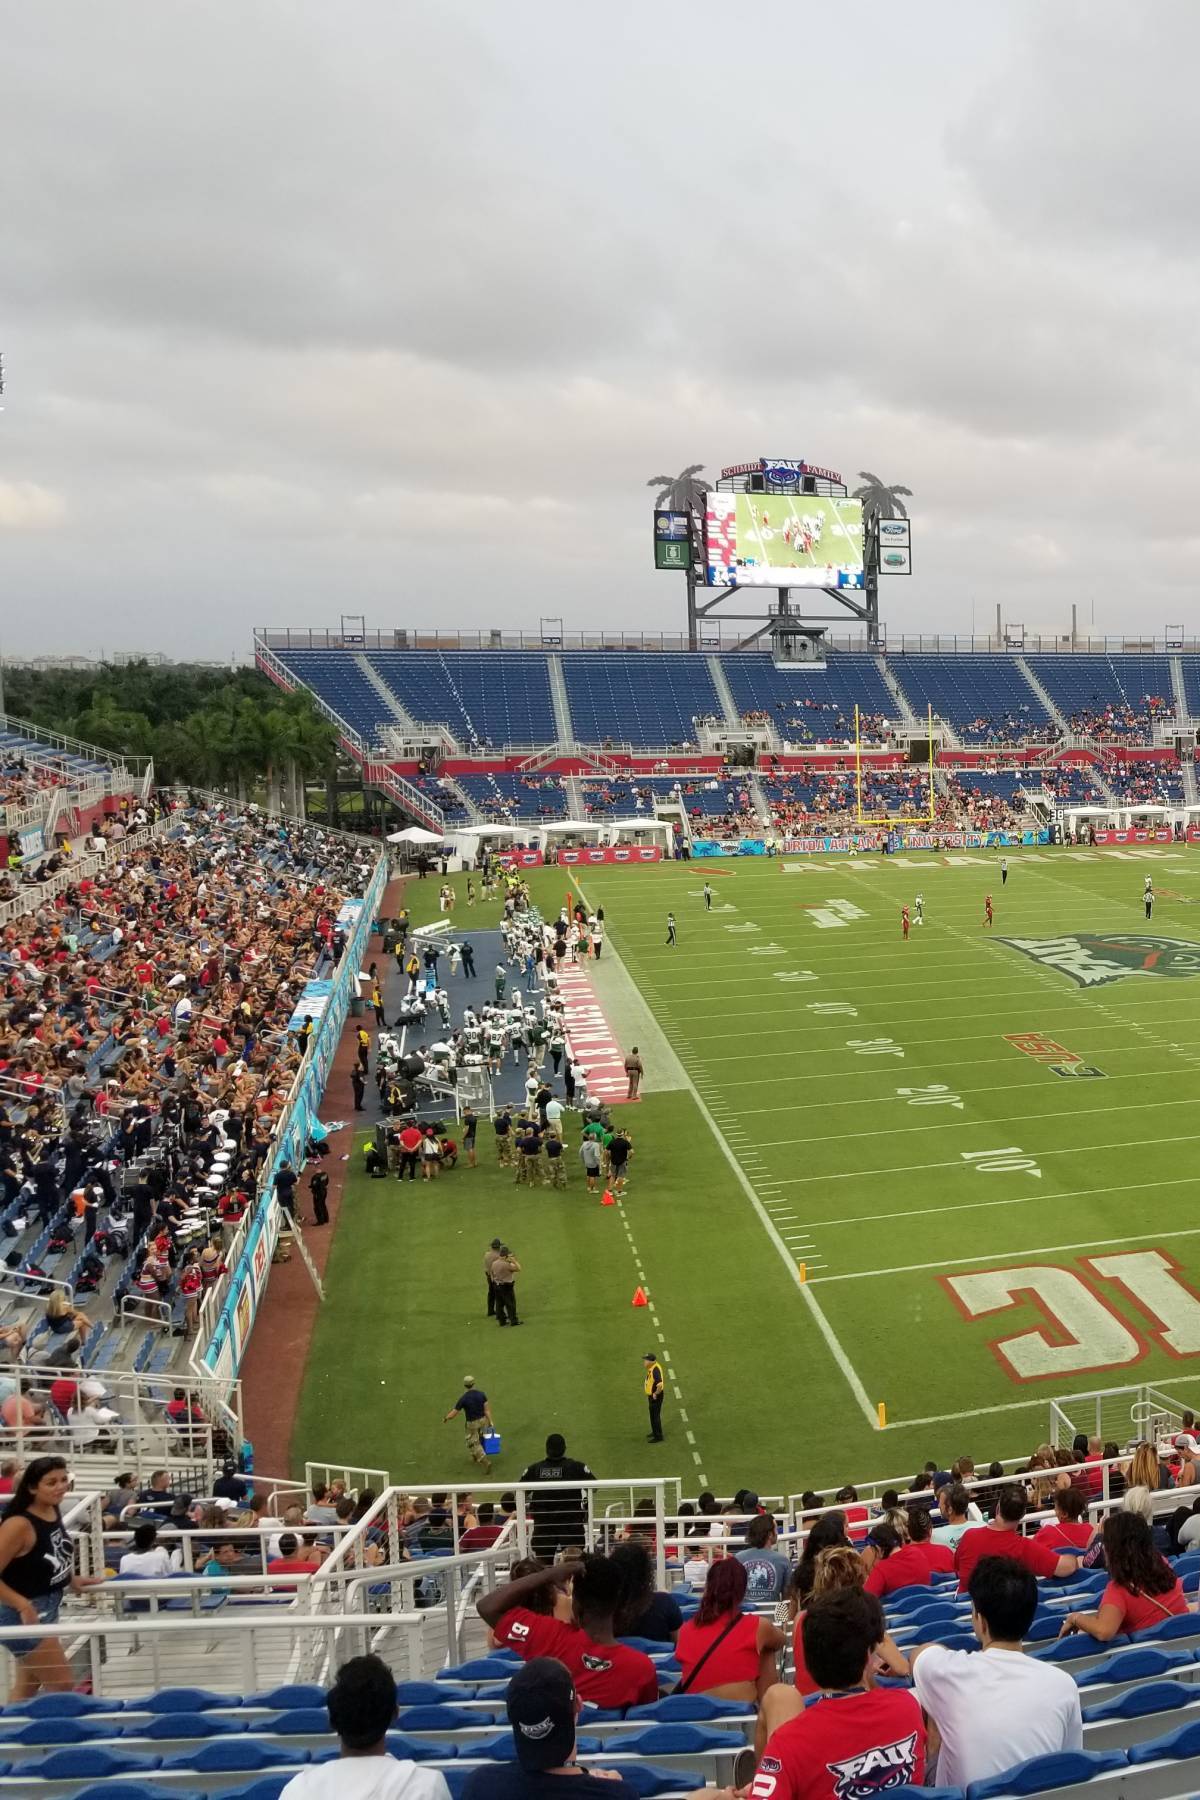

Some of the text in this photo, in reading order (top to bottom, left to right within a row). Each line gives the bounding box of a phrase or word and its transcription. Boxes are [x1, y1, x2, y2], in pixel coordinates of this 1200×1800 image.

[722, 463, 761, 478] SCHMIDT
[765, 459, 801, 472] FAU
[806, 463, 840, 481] FAMILY
[884, 525, 903, 535] Ford
[781, 849, 1186, 874] ATLANTIC
[466, 1031, 477, 1040] 30
[491, 1033, 501, 1042] 87
[845, 1037, 904, 1056] 30
[894, 1084, 962, 1106] 20
[959, 1146, 1039, 1173] 10
[838, 1737, 917, 1787] FAU
